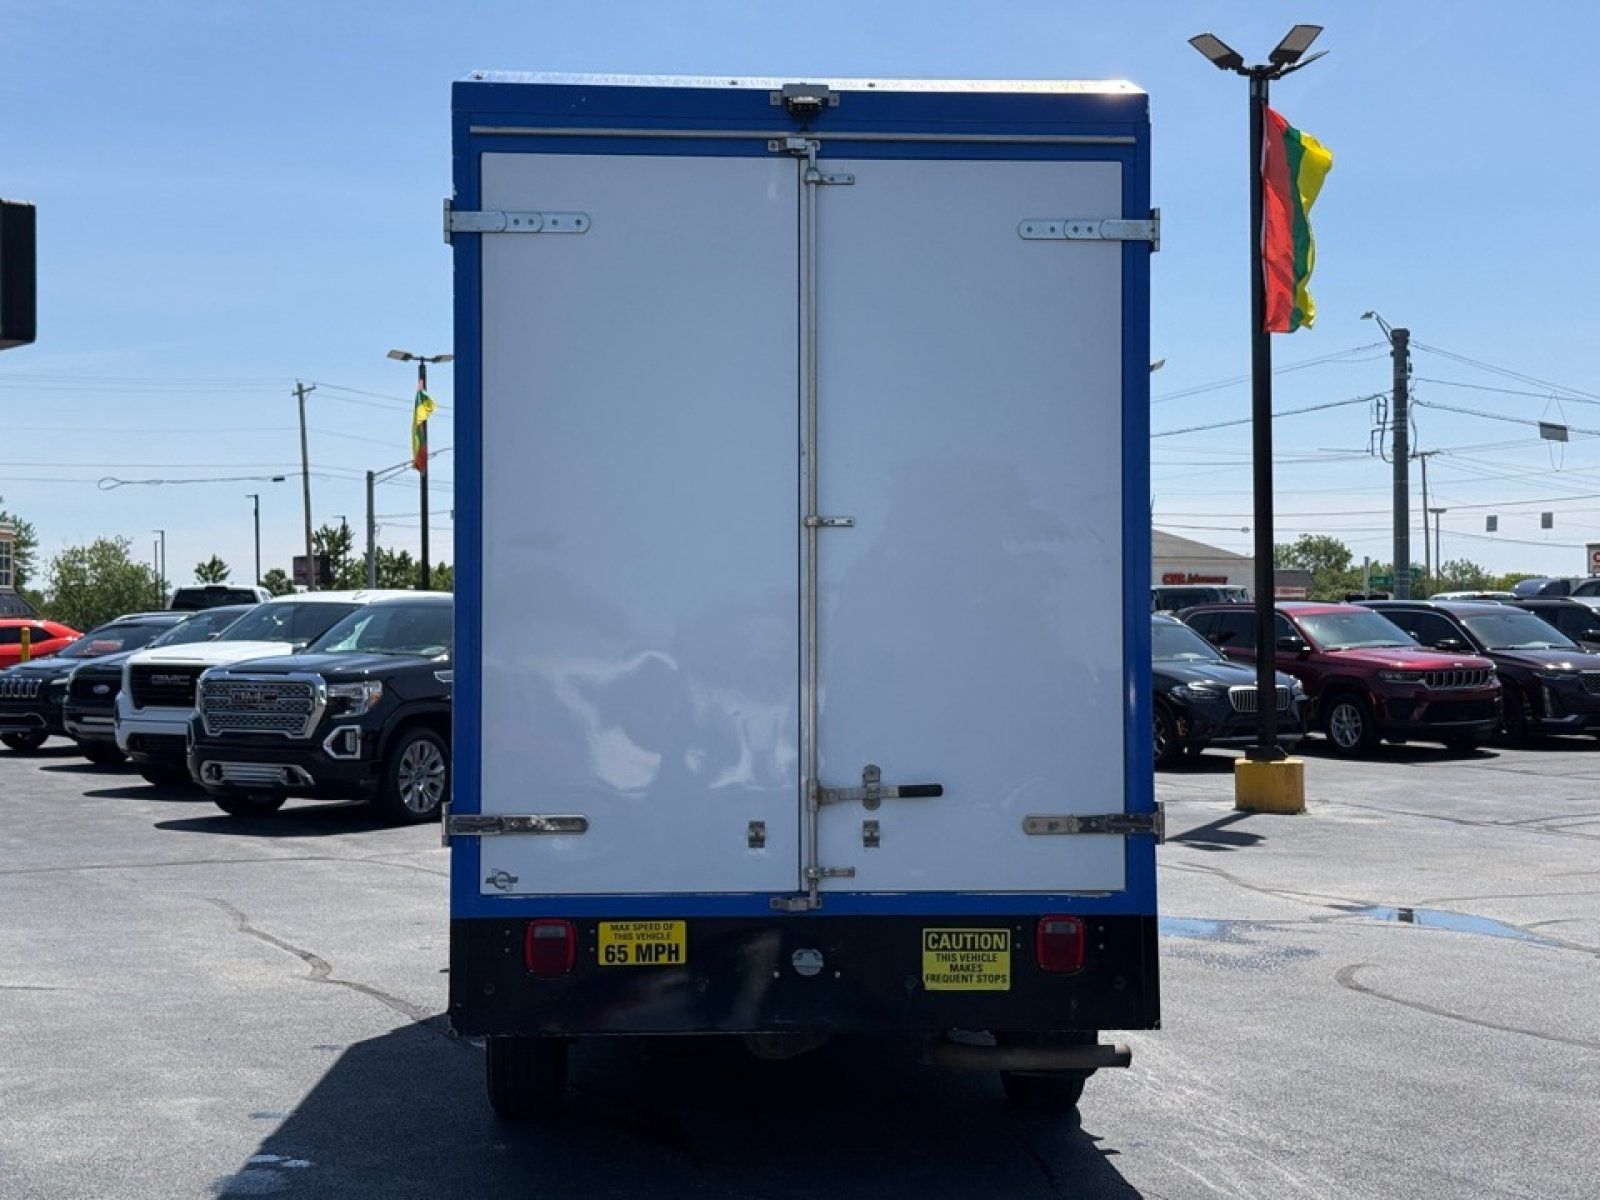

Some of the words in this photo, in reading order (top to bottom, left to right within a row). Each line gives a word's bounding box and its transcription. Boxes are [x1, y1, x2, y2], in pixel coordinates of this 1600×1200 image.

[610, 923, 630, 931] MAX
[632, 923, 661, 931] SPEED
[663, 922, 673, 931] OF
[614, 932, 633, 940] THIS
[636, 932, 672, 940] VEHICLE
[928, 932, 1006, 949] CAUTION
[604, 944, 628, 963] 65
[635, 943, 680, 962] MPH
[936, 953, 957, 962] THIS
[960, 953, 998, 962] VEHICLE
[949, 963, 983, 972] MAKES
[926, 973, 973, 983] FREQUENT
[976, 974, 1008, 984] STOPS
